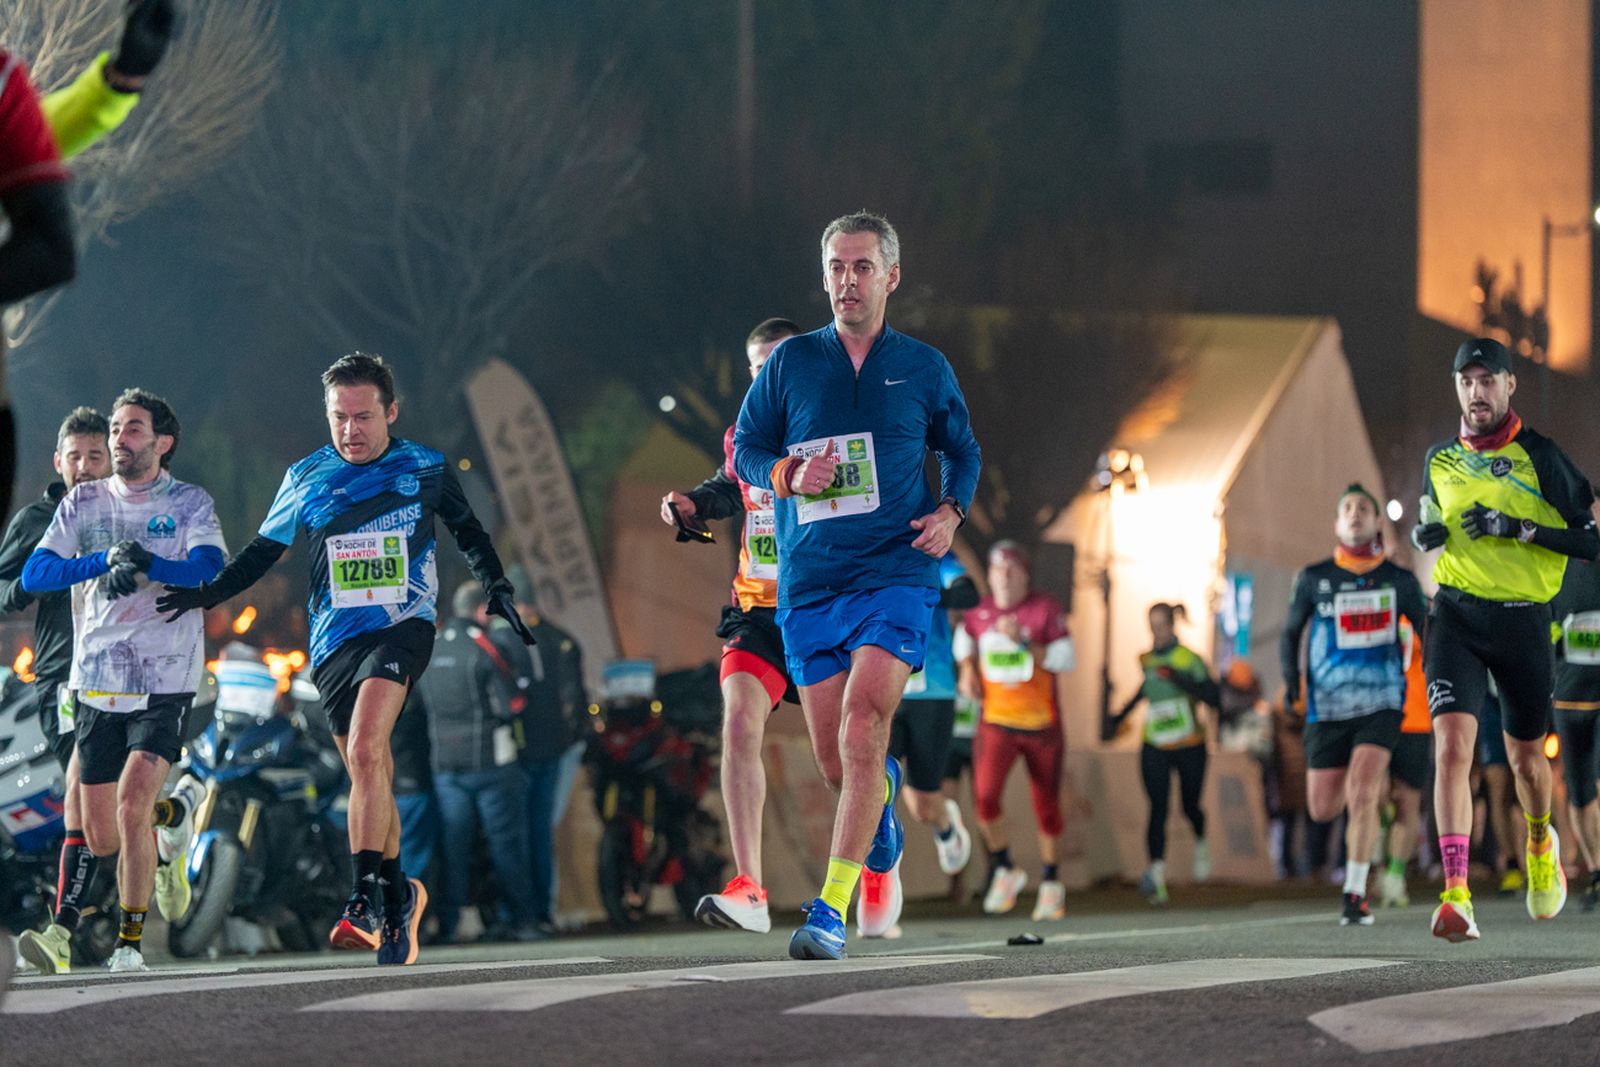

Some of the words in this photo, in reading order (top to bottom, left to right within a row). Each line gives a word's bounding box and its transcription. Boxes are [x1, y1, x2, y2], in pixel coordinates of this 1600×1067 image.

[343, 541, 366, 550] NOCHE
[367, 540, 377, 548] DE
[336, 550, 350, 560] SAN
[339, 557, 397, 583] 12789
